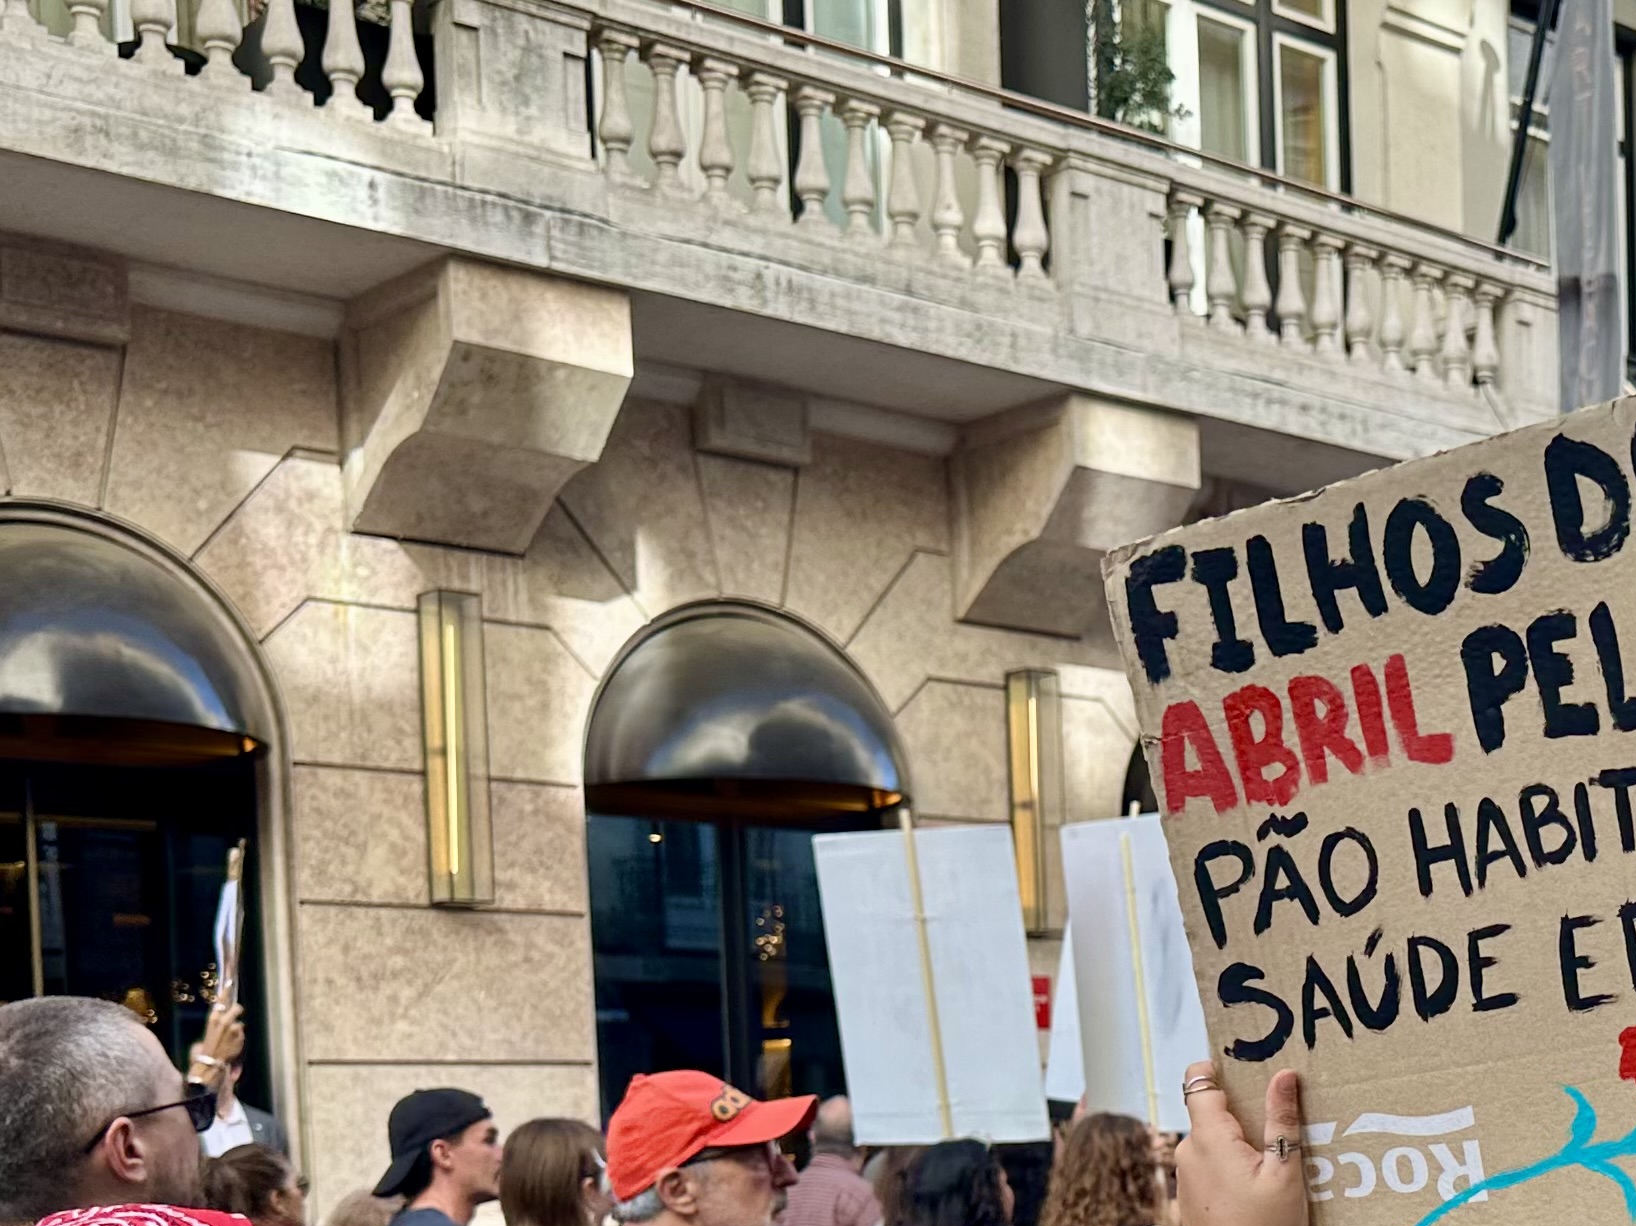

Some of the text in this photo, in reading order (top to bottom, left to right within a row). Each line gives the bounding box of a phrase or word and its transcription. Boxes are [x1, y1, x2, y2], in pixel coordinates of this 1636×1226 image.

[1124, 471, 1531, 687] FILHOS
[1157, 653, 1455, 814] ABRIL
[1193, 811, 1380, 951] PÃO
[1217, 923, 1520, 1063] SAÚDE
[1303, 1138, 1490, 1204] Roca
